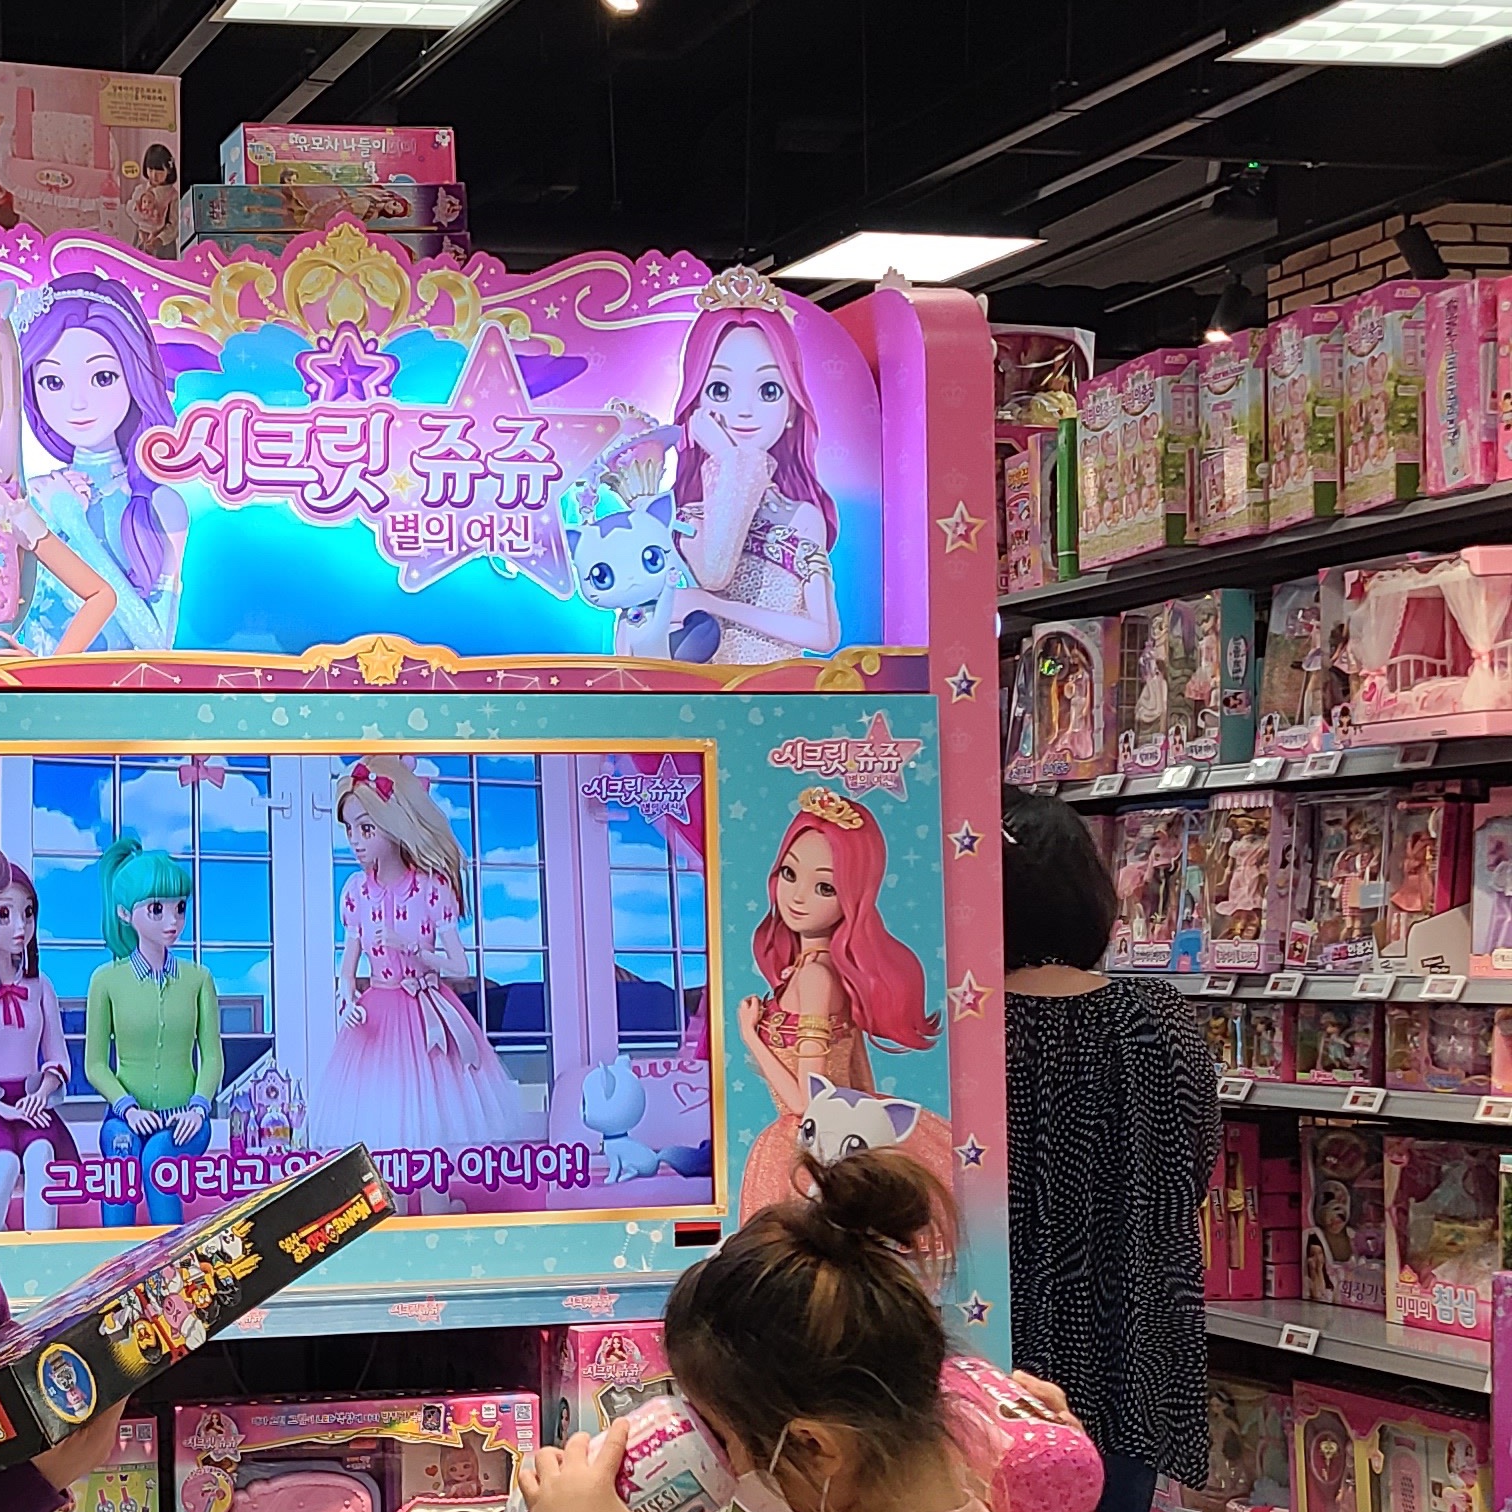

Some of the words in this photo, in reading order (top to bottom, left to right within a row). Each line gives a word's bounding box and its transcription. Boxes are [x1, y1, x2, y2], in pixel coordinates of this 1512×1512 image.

[142, 406, 391, 513] 시크릿
[411, 414, 562, 508] 쥬쥬
[390, 514, 455, 552] 별의
[467, 514, 531, 552] 여신
[773, 741, 849, 774] 시크릿
[855, 743, 904, 773] 쥬쥬
[582, 776, 644, 804] 시크릿
[647, 777, 686, 801] 쥬쥬
[44, 1162, 139, 1201] 그래!
[155, 1157, 271, 1196] 이러고
[462, 1145, 587, 1187] 아니야!
[1396, 1296, 1432, 1320] 미미의
